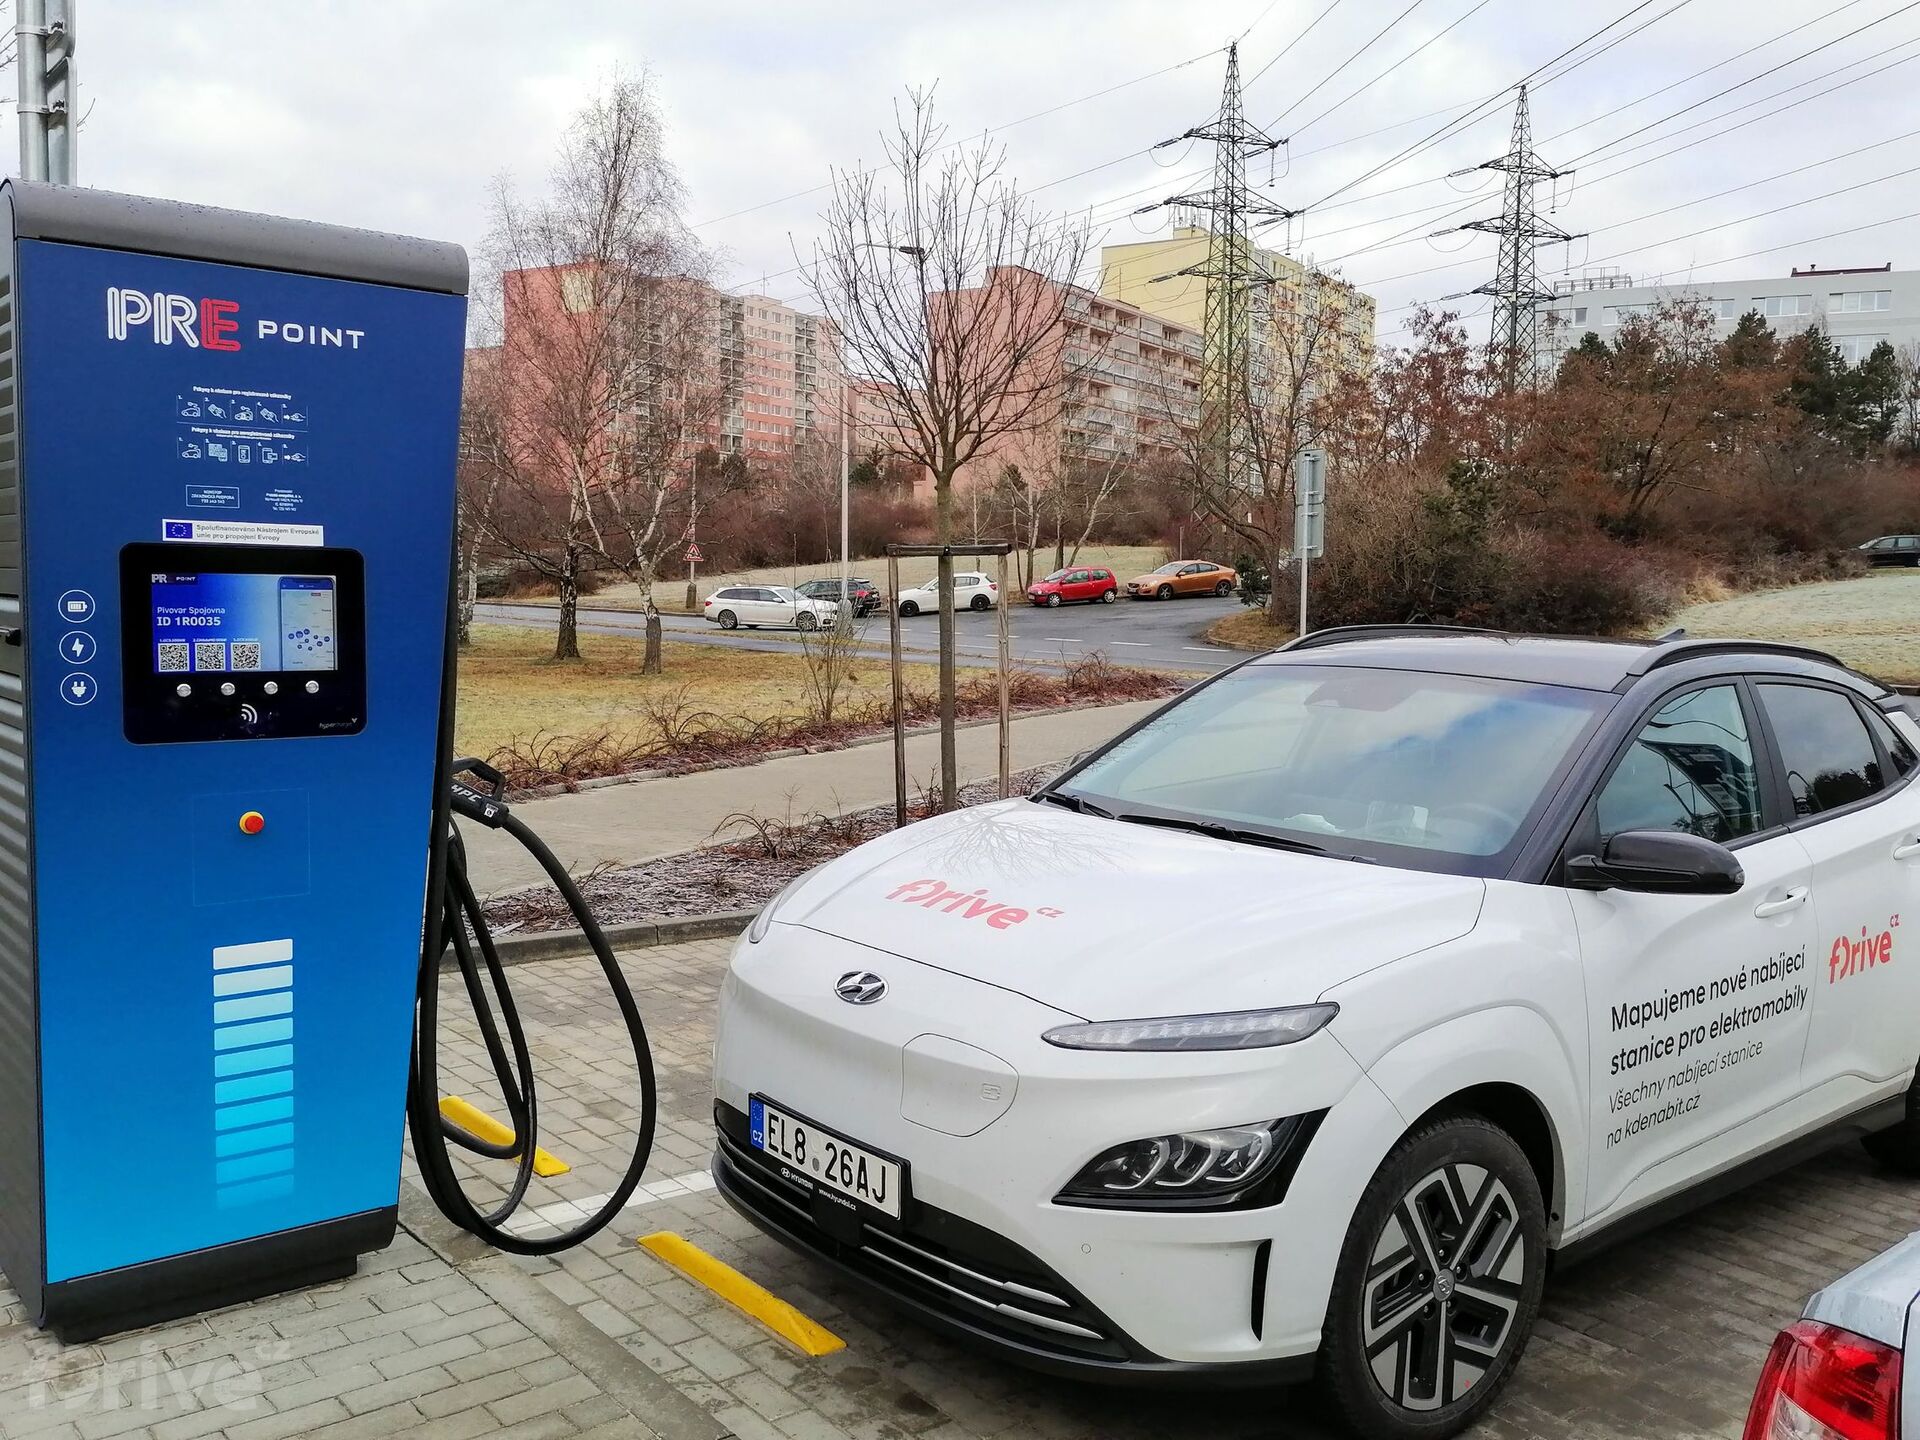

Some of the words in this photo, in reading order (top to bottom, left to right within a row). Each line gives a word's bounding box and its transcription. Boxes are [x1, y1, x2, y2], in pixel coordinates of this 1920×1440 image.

[107, 286, 241, 352] PRE
[258, 319, 365, 349] POINT
[196, 524, 256, 534] Spolufinancováno
[256, 525, 289, 535] Nástrojem
[225, 533, 257, 541] propojení
[257, 534, 280, 542] Evropy
[156, 616, 171, 627] ID
[174, 616, 221, 627] 1R0035
[157, 606, 187, 615] Pivovar
[188, 606, 226, 616] Spojovna
[884, 878, 1029, 930] fDrive
[1828, 925, 1892, 985] fDrive
[1611, 984, 1706, 1032] Mapujeme
[1709, 964, 1747, 1001] nové
[1750, 944, 1806, 987] nabíjecí
[1610, 1034, 1675, 1076] stanice
[1677, 1025, 1706, 1057] pro
[1709, 984, 1809, 1040] elektromobily
[1608, 1078, 1666, 1114] Všechny
[1667, 1052, 1720, 1091] nabíjecí
[1720, 1040, 1763, 1070] stanice
[752, 1129, 764, 1144] CZ
[1606, 1126, 1623, 1149] na
[1624, 1093, 1701, 1139] kdenabit.cz
[768, 1111, 807, 1166] EL8
[824, 1141, 886, 1204] 26AJ
